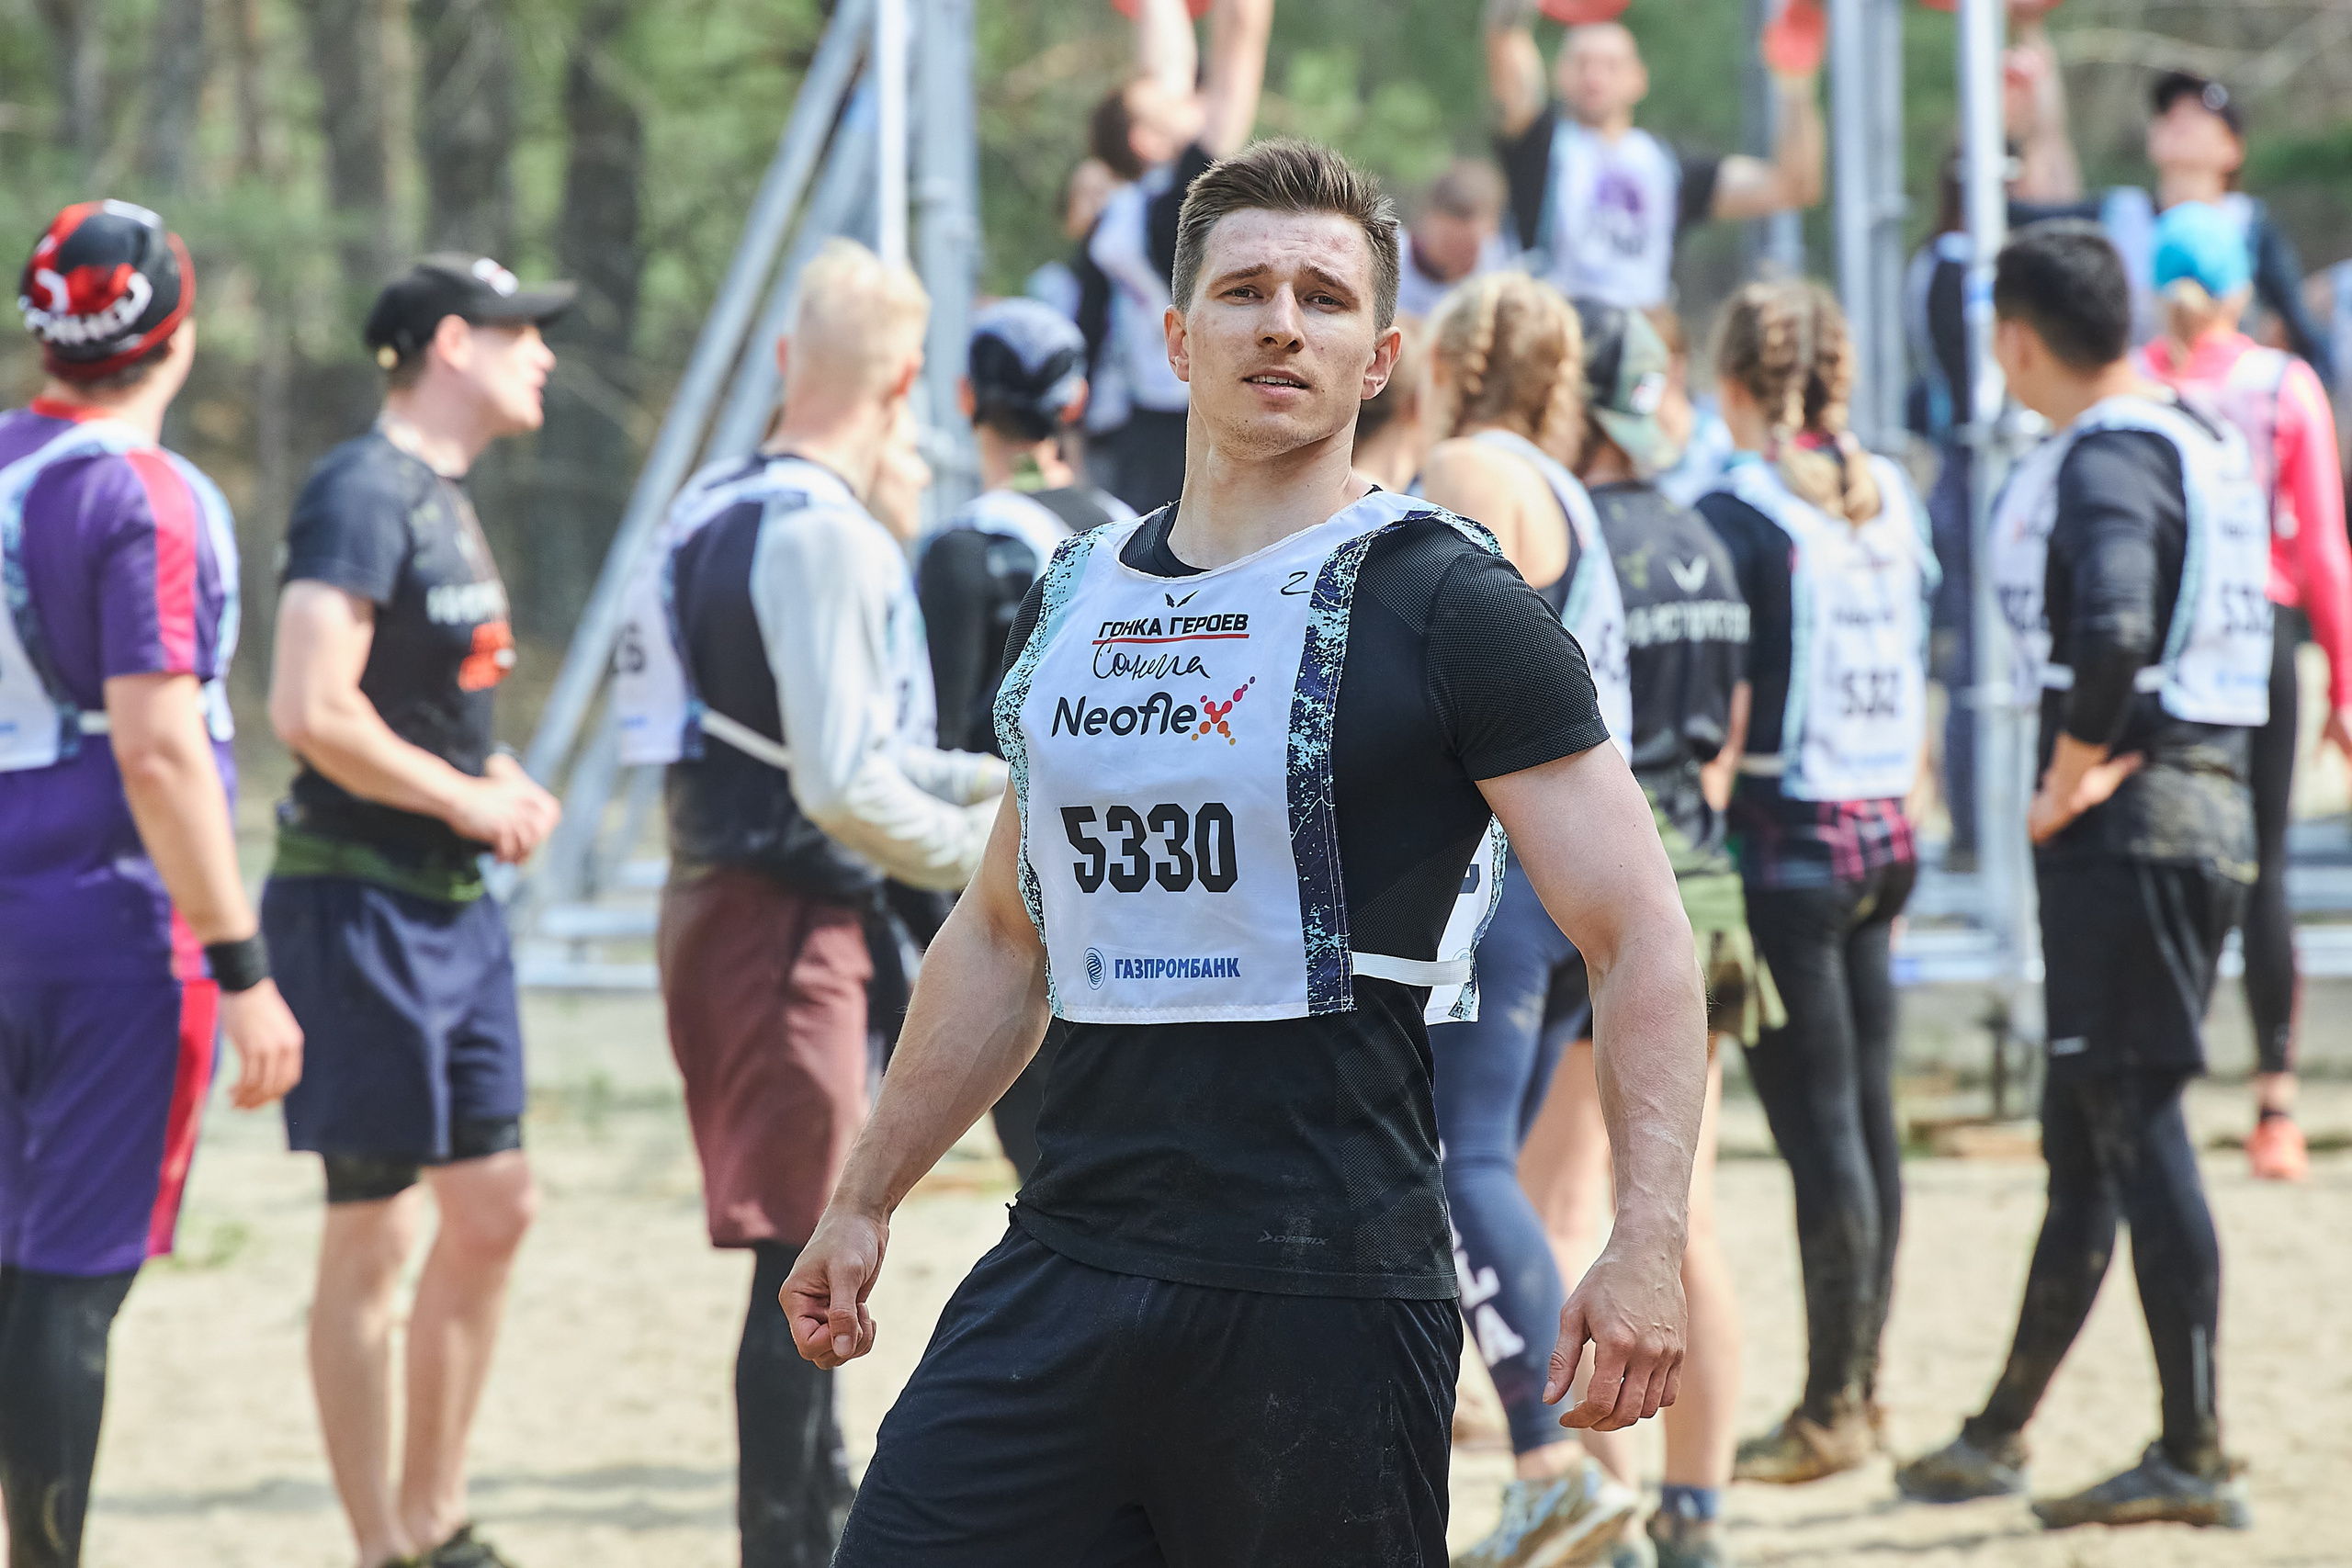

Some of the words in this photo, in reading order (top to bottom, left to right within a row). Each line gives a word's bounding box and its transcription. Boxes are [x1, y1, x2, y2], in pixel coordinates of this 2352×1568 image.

[1280, 570, 1311, 596] 2
[1098, 617, 1162, 638] ГОНКА
[1169, 614, 1249, 637] ГЕРОЕВ
[1050, 675, 1256, 746] Neoflex
[1059, 802, 1239, 894] 5330
[1114, 957, 1241, 980] ГАЗПРОМБАНК
